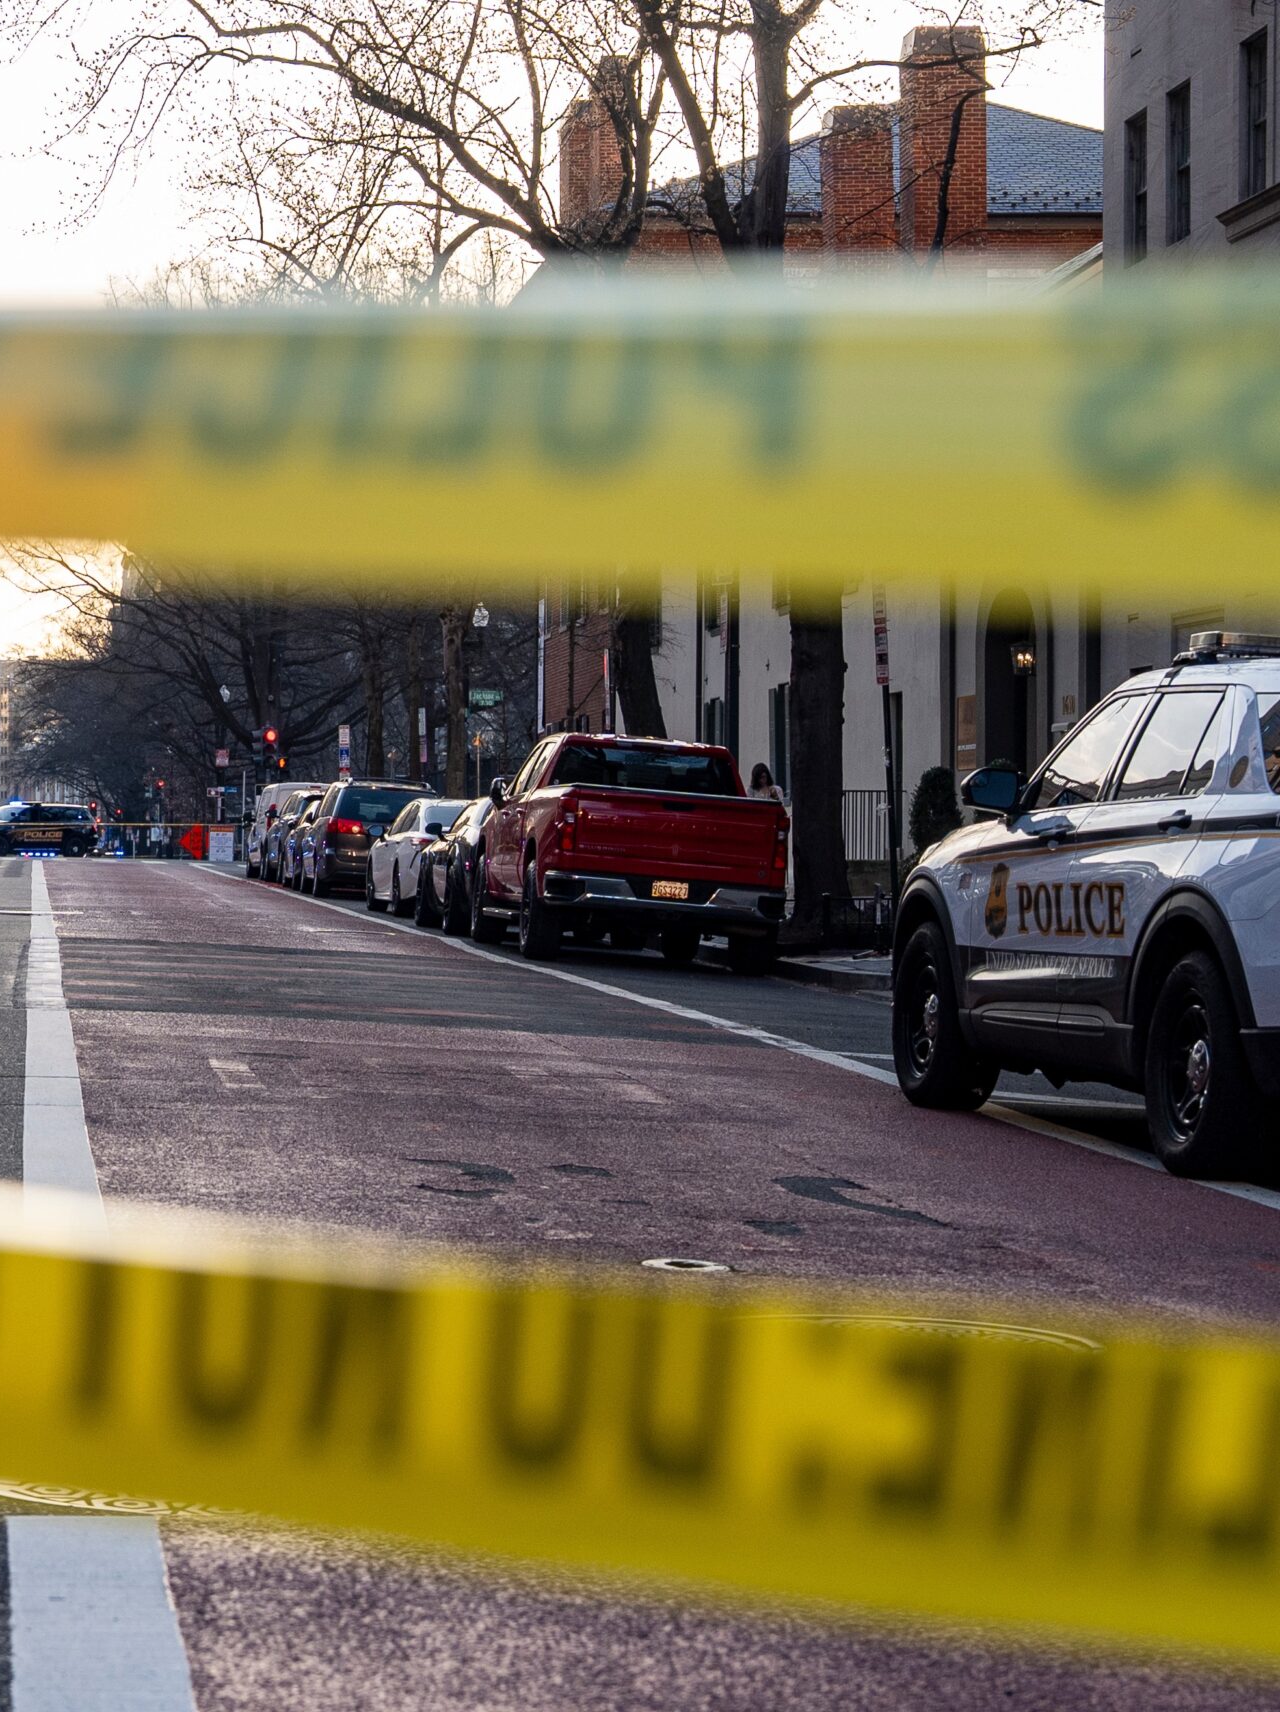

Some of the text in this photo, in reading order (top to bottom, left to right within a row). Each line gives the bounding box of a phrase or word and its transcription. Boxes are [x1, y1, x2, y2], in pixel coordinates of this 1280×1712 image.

[1016, 881, 1126, 938] POLICE
[985, 950, 1015, 970] UNITED
[1045, 955, 1077, 976] SECRET
[1078, 957, 1115, 978] SERVICE
